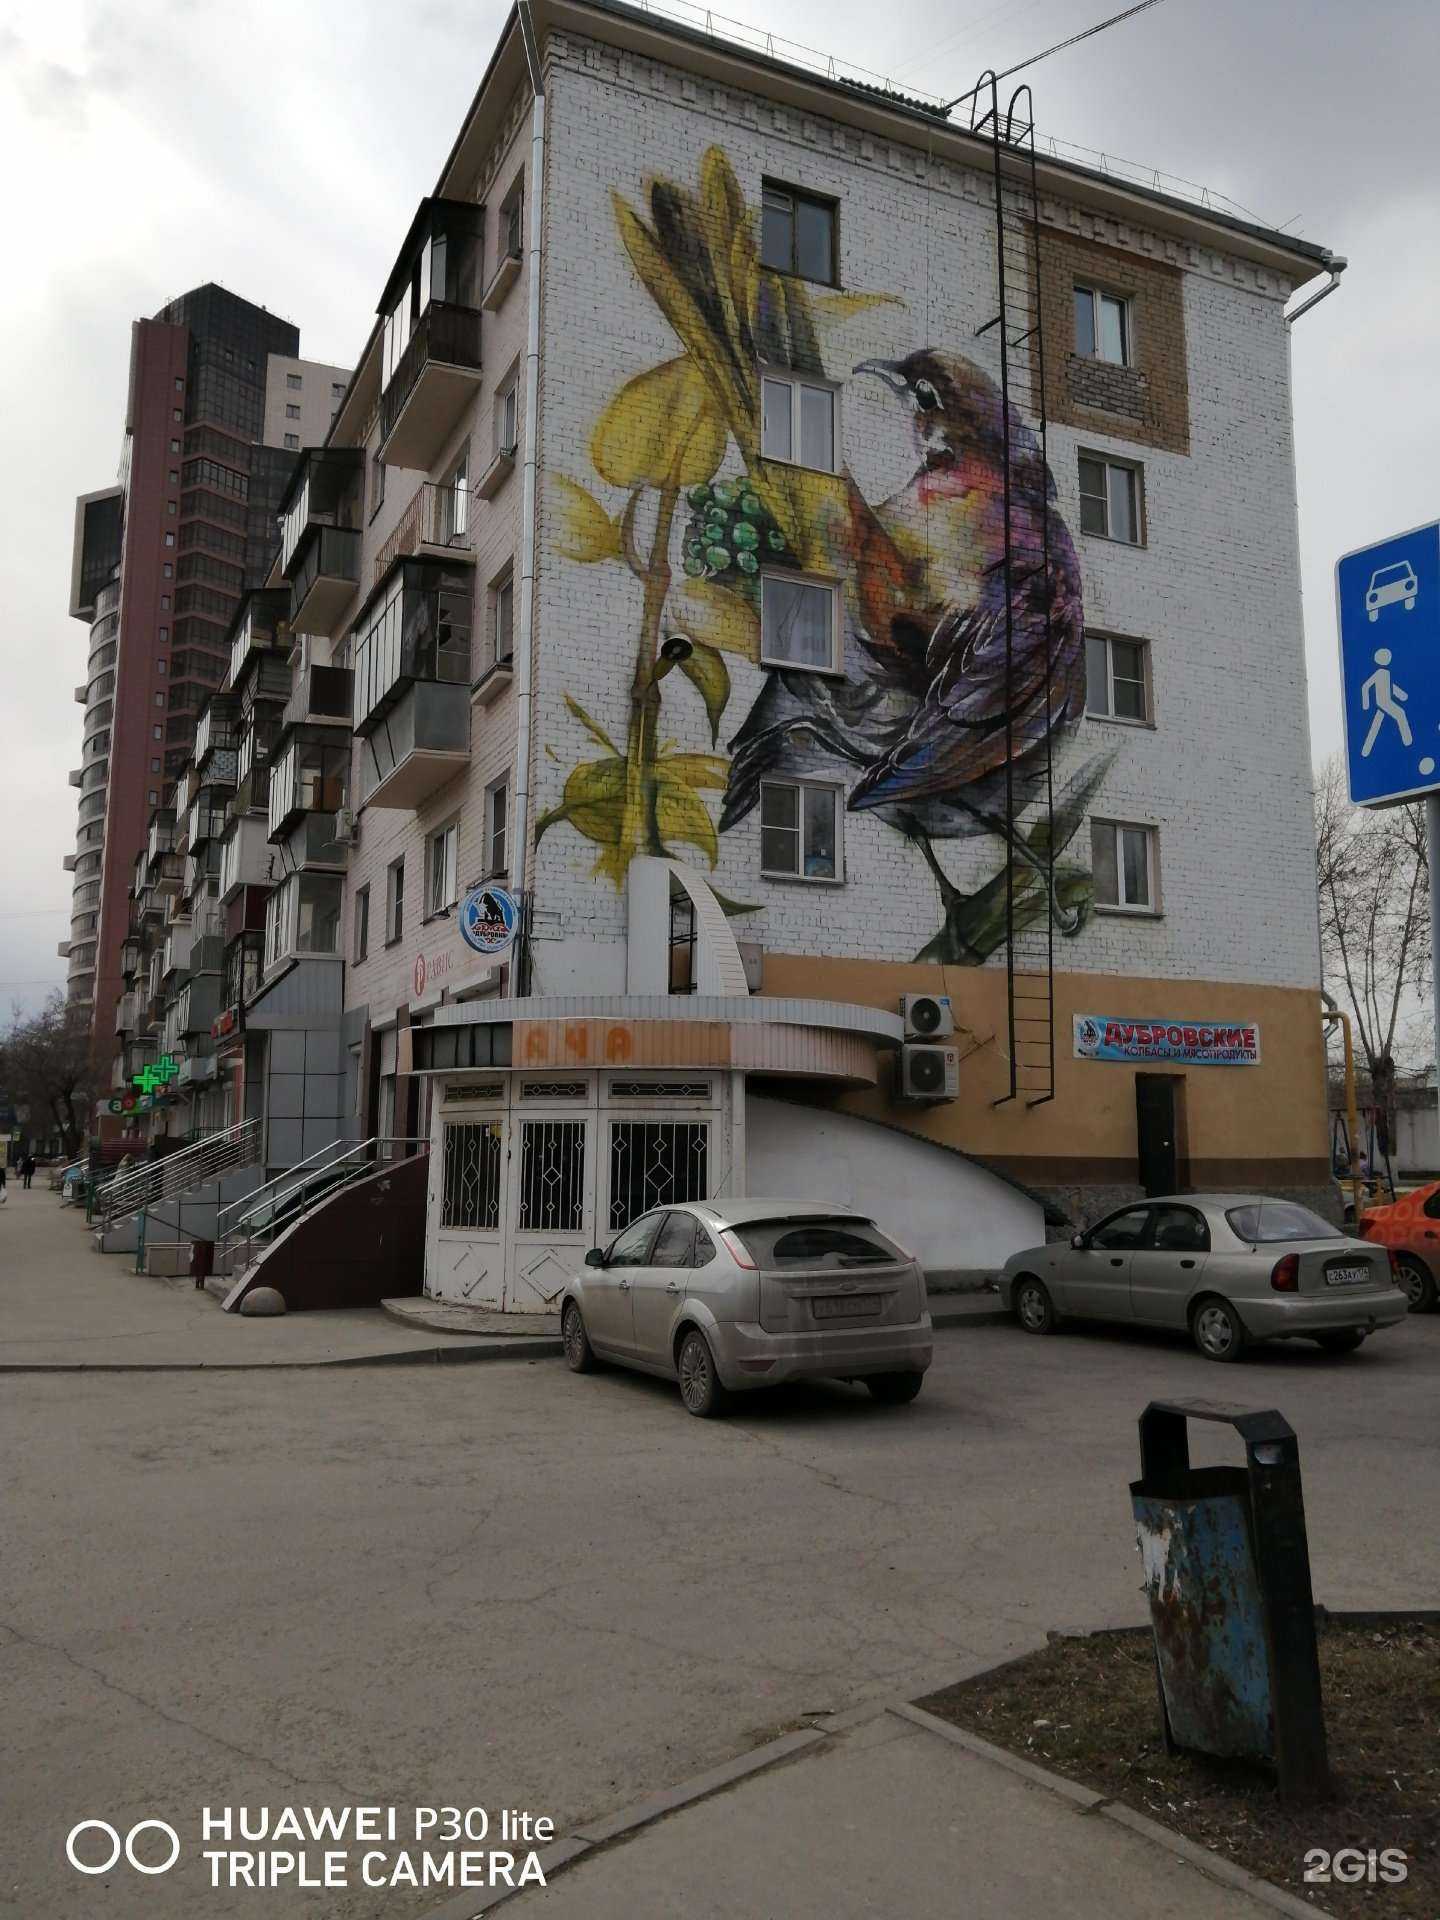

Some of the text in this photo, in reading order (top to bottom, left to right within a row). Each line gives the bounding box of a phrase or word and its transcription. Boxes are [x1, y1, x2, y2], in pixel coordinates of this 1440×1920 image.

[1104, 1022, 1256, 1048] ДУБРОВСКИЕ
[1124, 1047, 1257, 1061] КОЛБАСЫ И МЯСОПРОДУКТЫ
